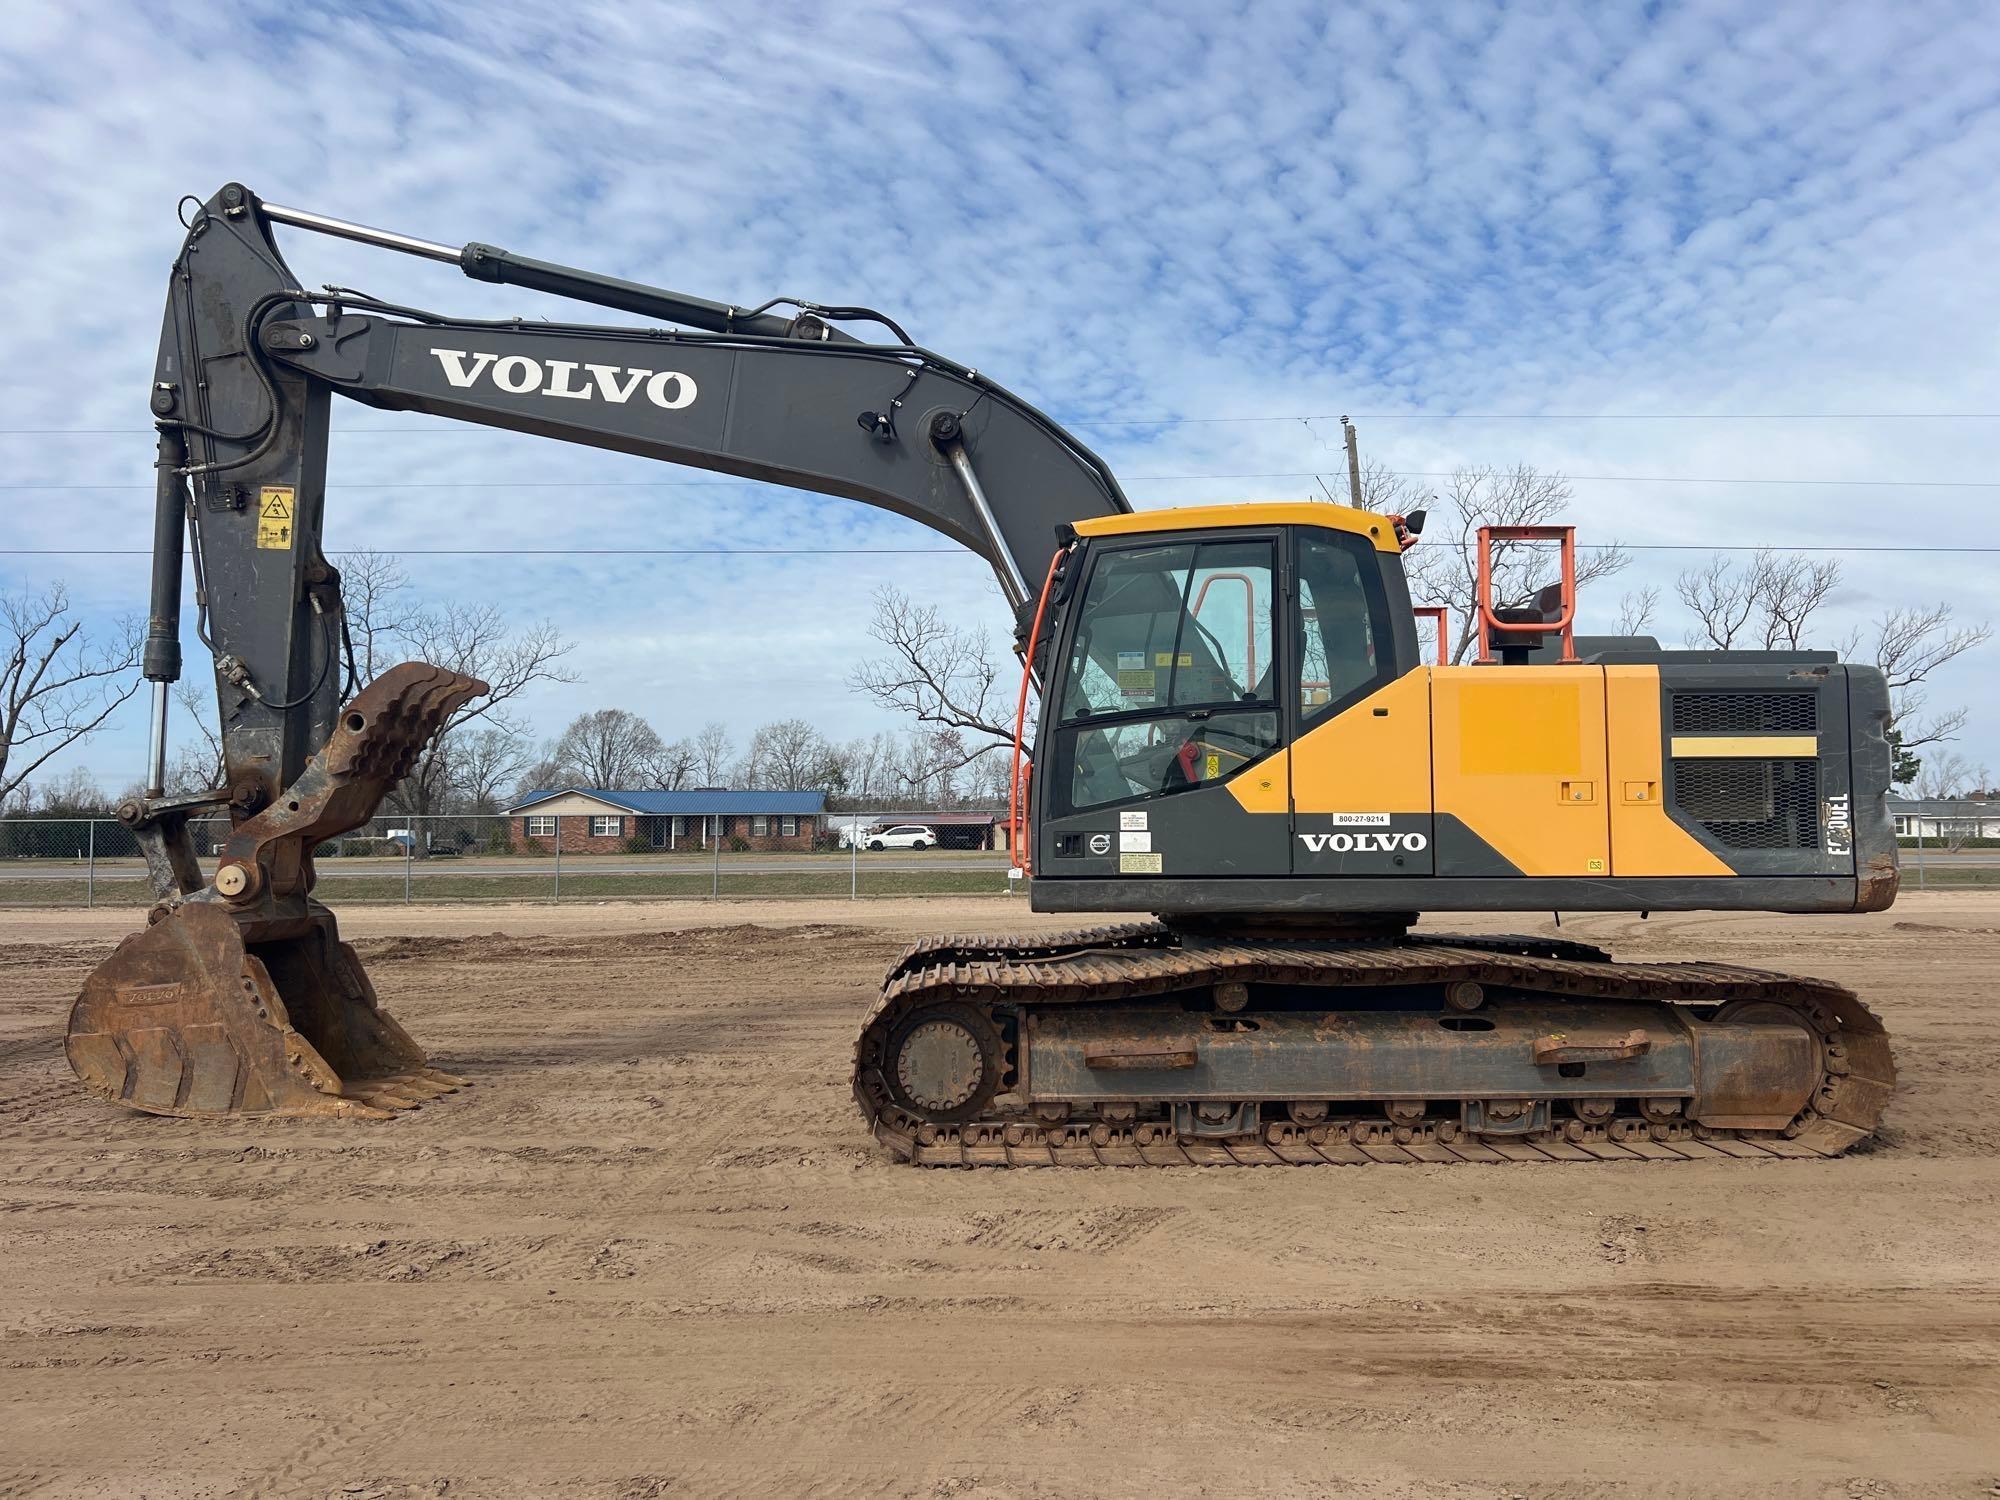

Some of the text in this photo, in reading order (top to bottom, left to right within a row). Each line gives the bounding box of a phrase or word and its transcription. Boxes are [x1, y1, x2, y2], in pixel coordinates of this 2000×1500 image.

[430, 348, 698, 409] VOLVO
[1338, 815, 1384, 823] 800-27-9214
[1298, 832, 1427, 852] VOLVO
